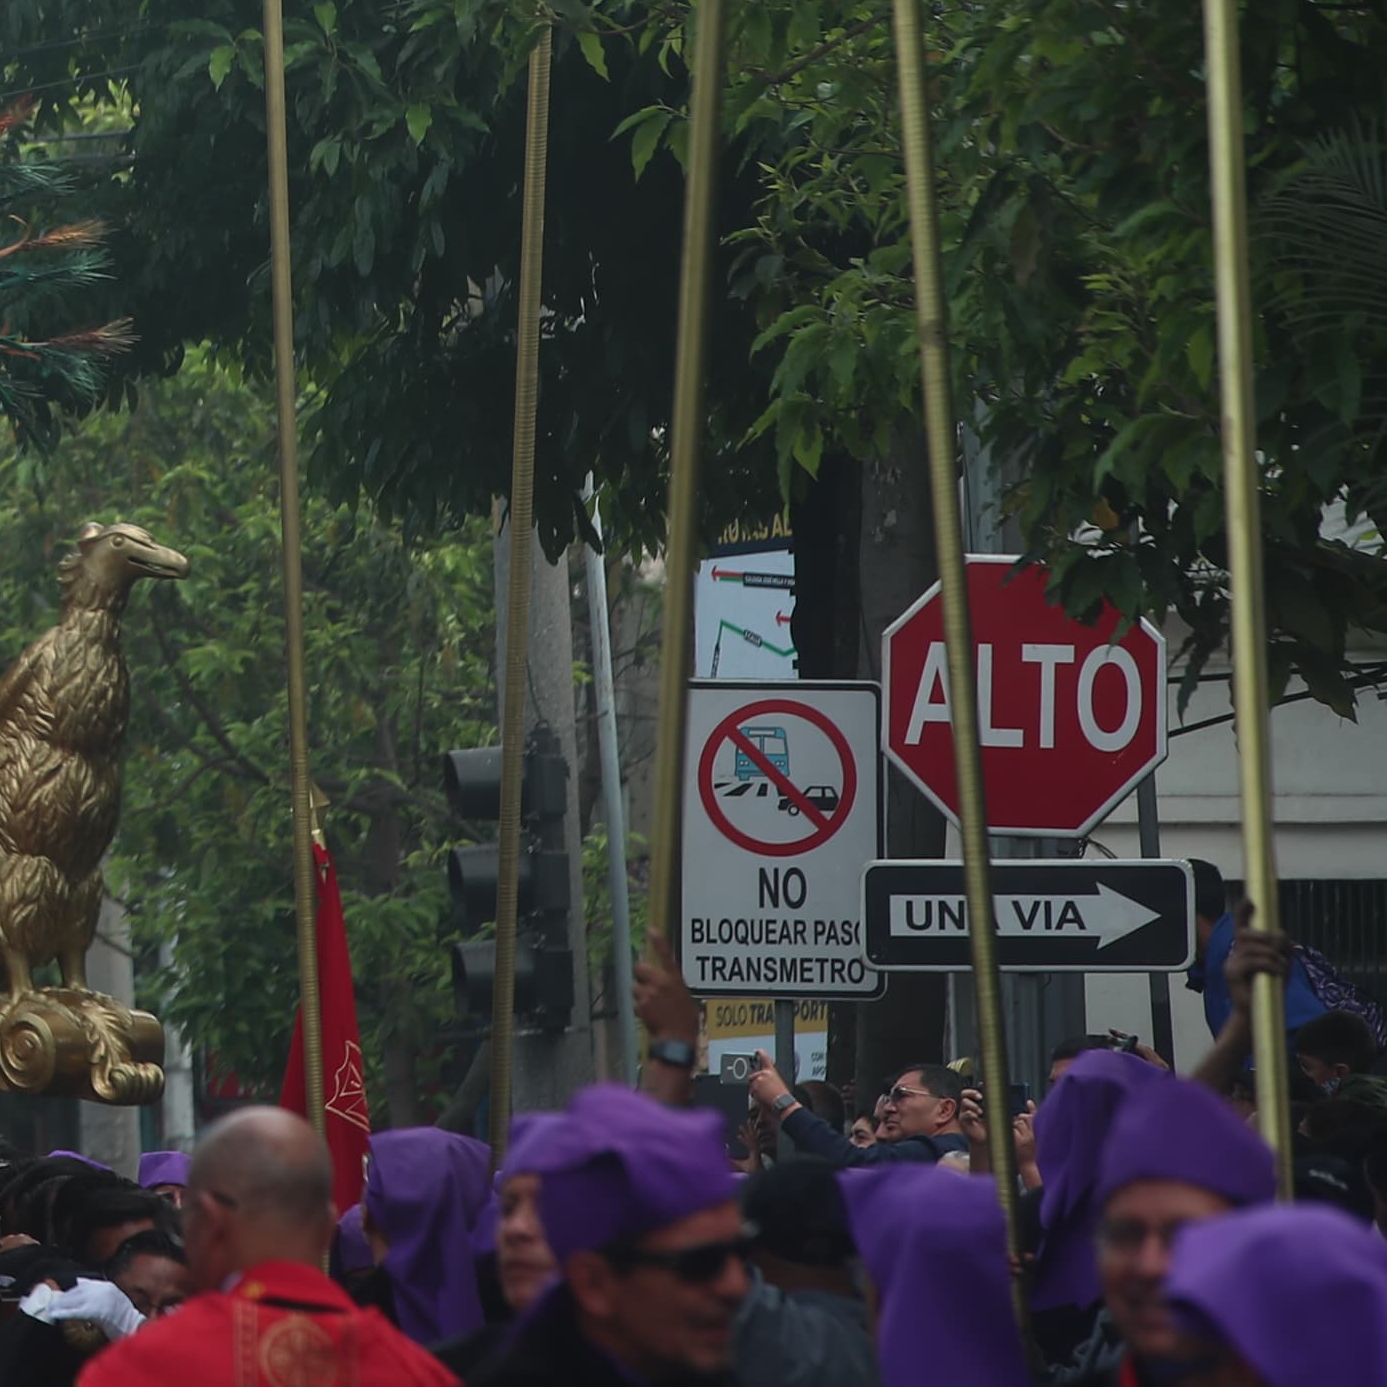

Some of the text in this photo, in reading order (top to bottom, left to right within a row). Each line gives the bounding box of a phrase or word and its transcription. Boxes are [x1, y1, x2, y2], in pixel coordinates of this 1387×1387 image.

[904, 641, 1142, 752] ALTO
[759, 867, 807, 909] NO
[905, 900, 1086, 930] UN VIA
[691, 918, 807, 946] BLOQUEAR
[696, 956, 865, 984] TRANSMETRO
[716, 1005, 747, 1027] SOLO
